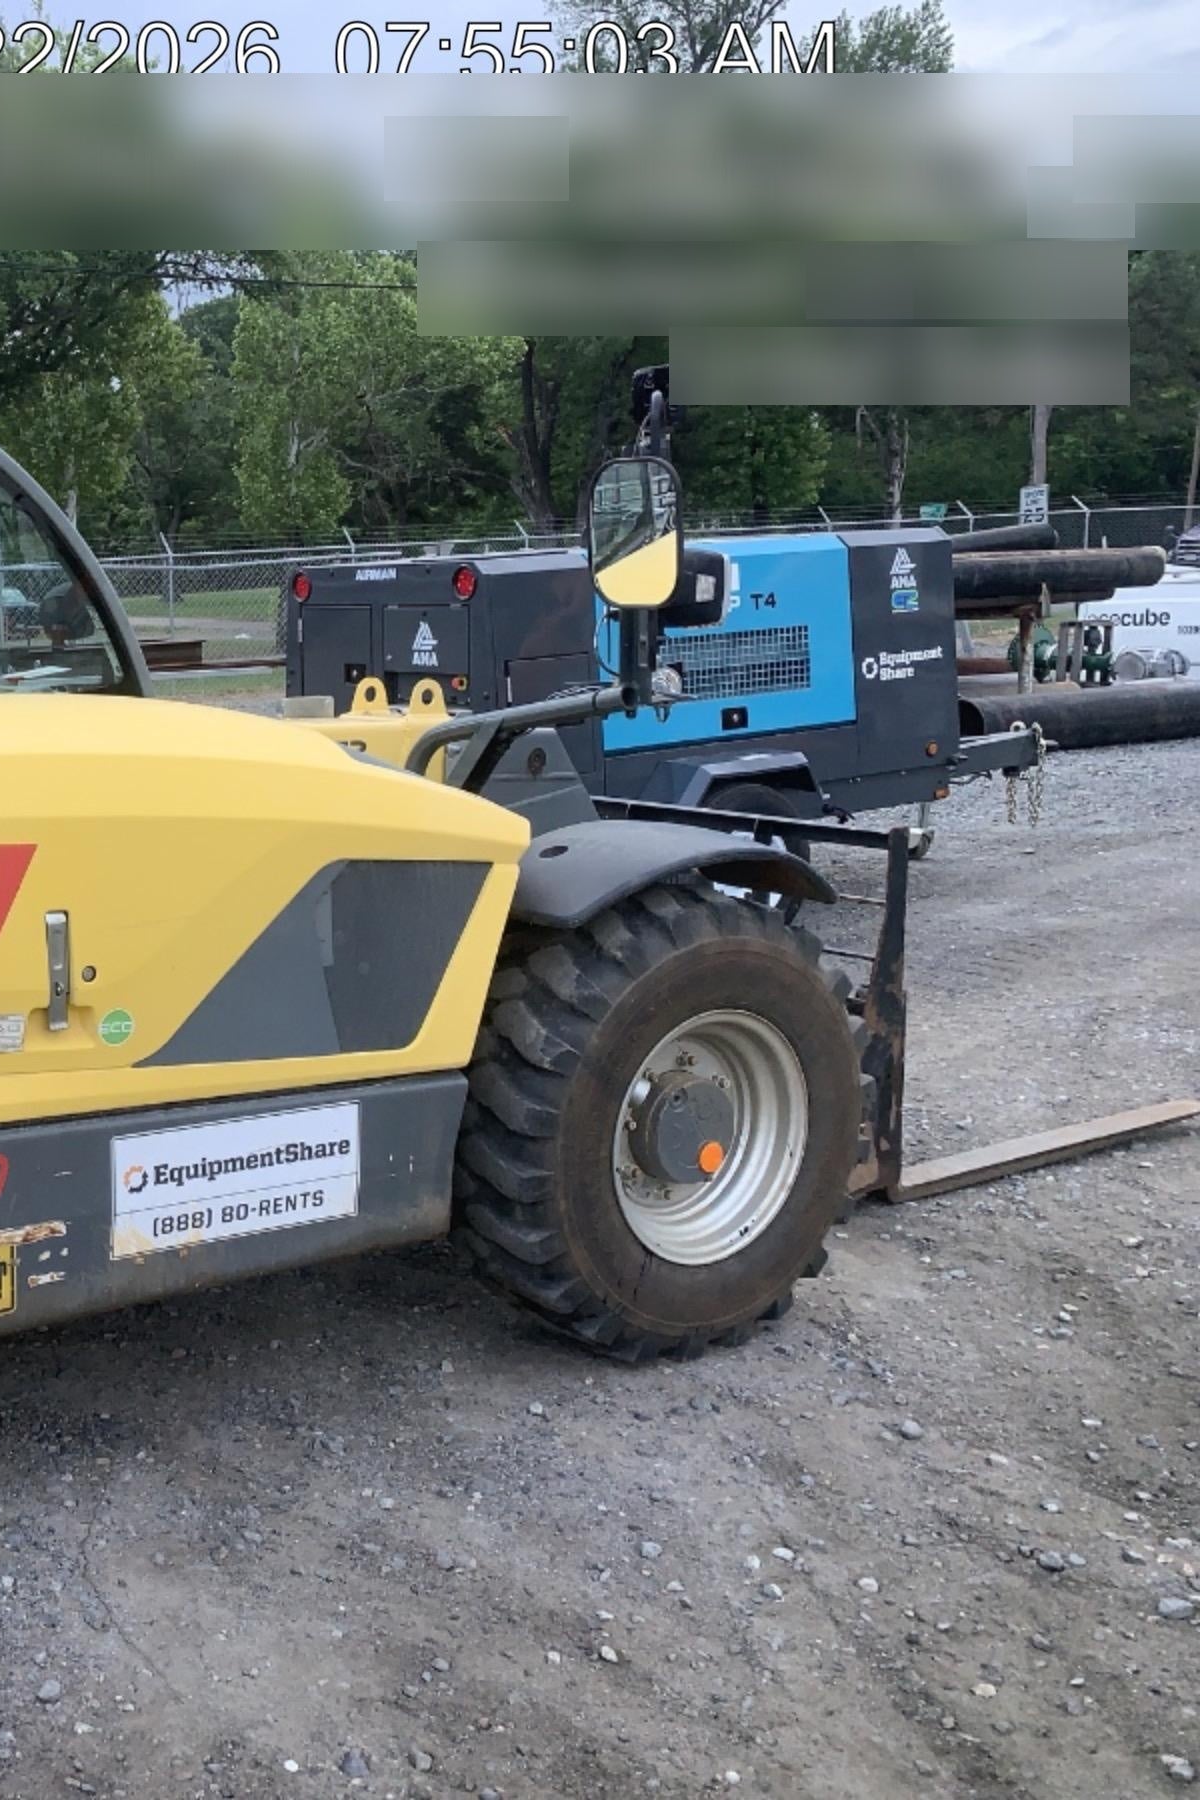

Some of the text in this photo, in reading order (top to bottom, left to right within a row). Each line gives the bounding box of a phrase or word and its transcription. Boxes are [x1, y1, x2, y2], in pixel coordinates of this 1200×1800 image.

[749, 592, 777, 610] T4
[879, 646, 943, 667] Equipment
[153, 1138, 351, 1187] EquipmentShare
[153, 1189, 325, 1238] (888) 80-RENTS
